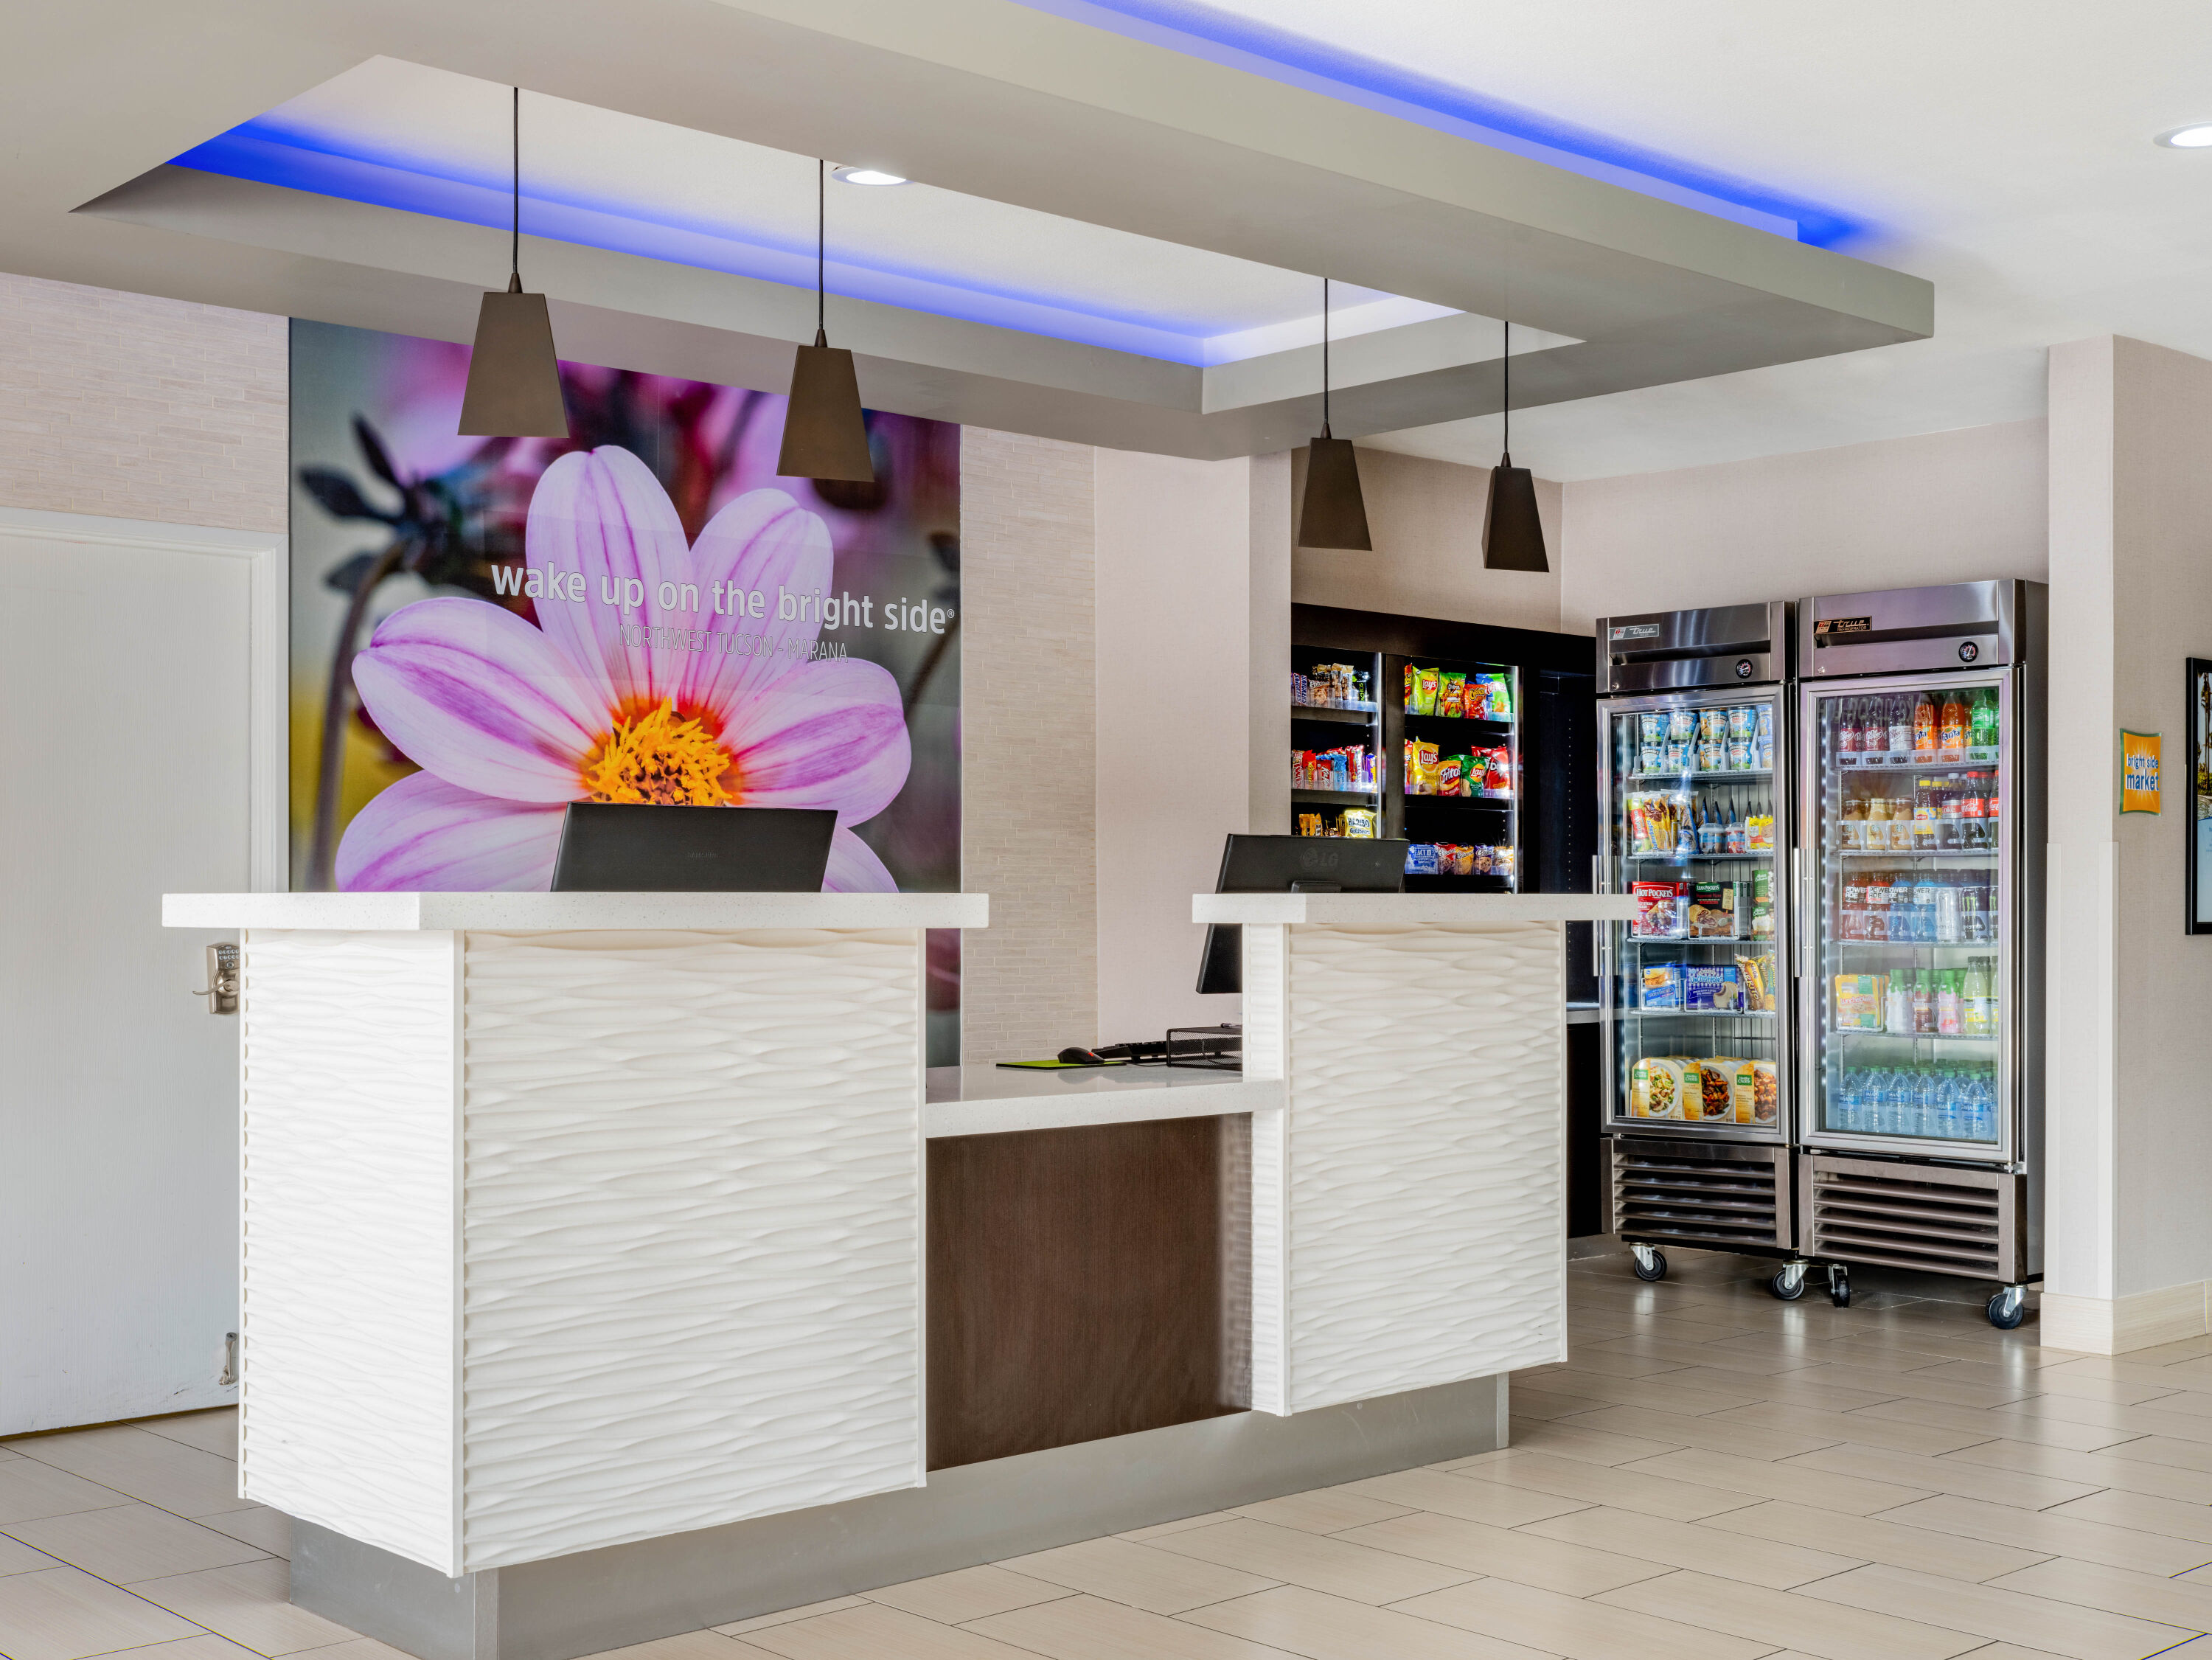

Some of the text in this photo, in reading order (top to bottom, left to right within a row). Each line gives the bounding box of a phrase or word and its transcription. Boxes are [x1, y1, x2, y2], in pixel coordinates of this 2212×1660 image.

[491, 561, 587, 602] wake
[601, 575, 644, 615] up
[658, 581, 699, 613] on
[712, 580, 765, 619] the
[779, 585, 874, 630] bright
[619, 624, 712, 653] NORTHWEST
[717, 632, 773, 658] TUCSON
[787, 638, 848, 663] MARANA
[1422, 678, 1437, 691] Lay's
[1420, 750, 1438, 765] Lay's
[2126, 753, 2159, 770] bright side
[1440, 766, 1460, 783] Fritos
[1472, 768, 1485, 778] Lay's
[2126, 768, 2160, 791] market
[1636, 888, 1673, 897] HOT POCKETS
